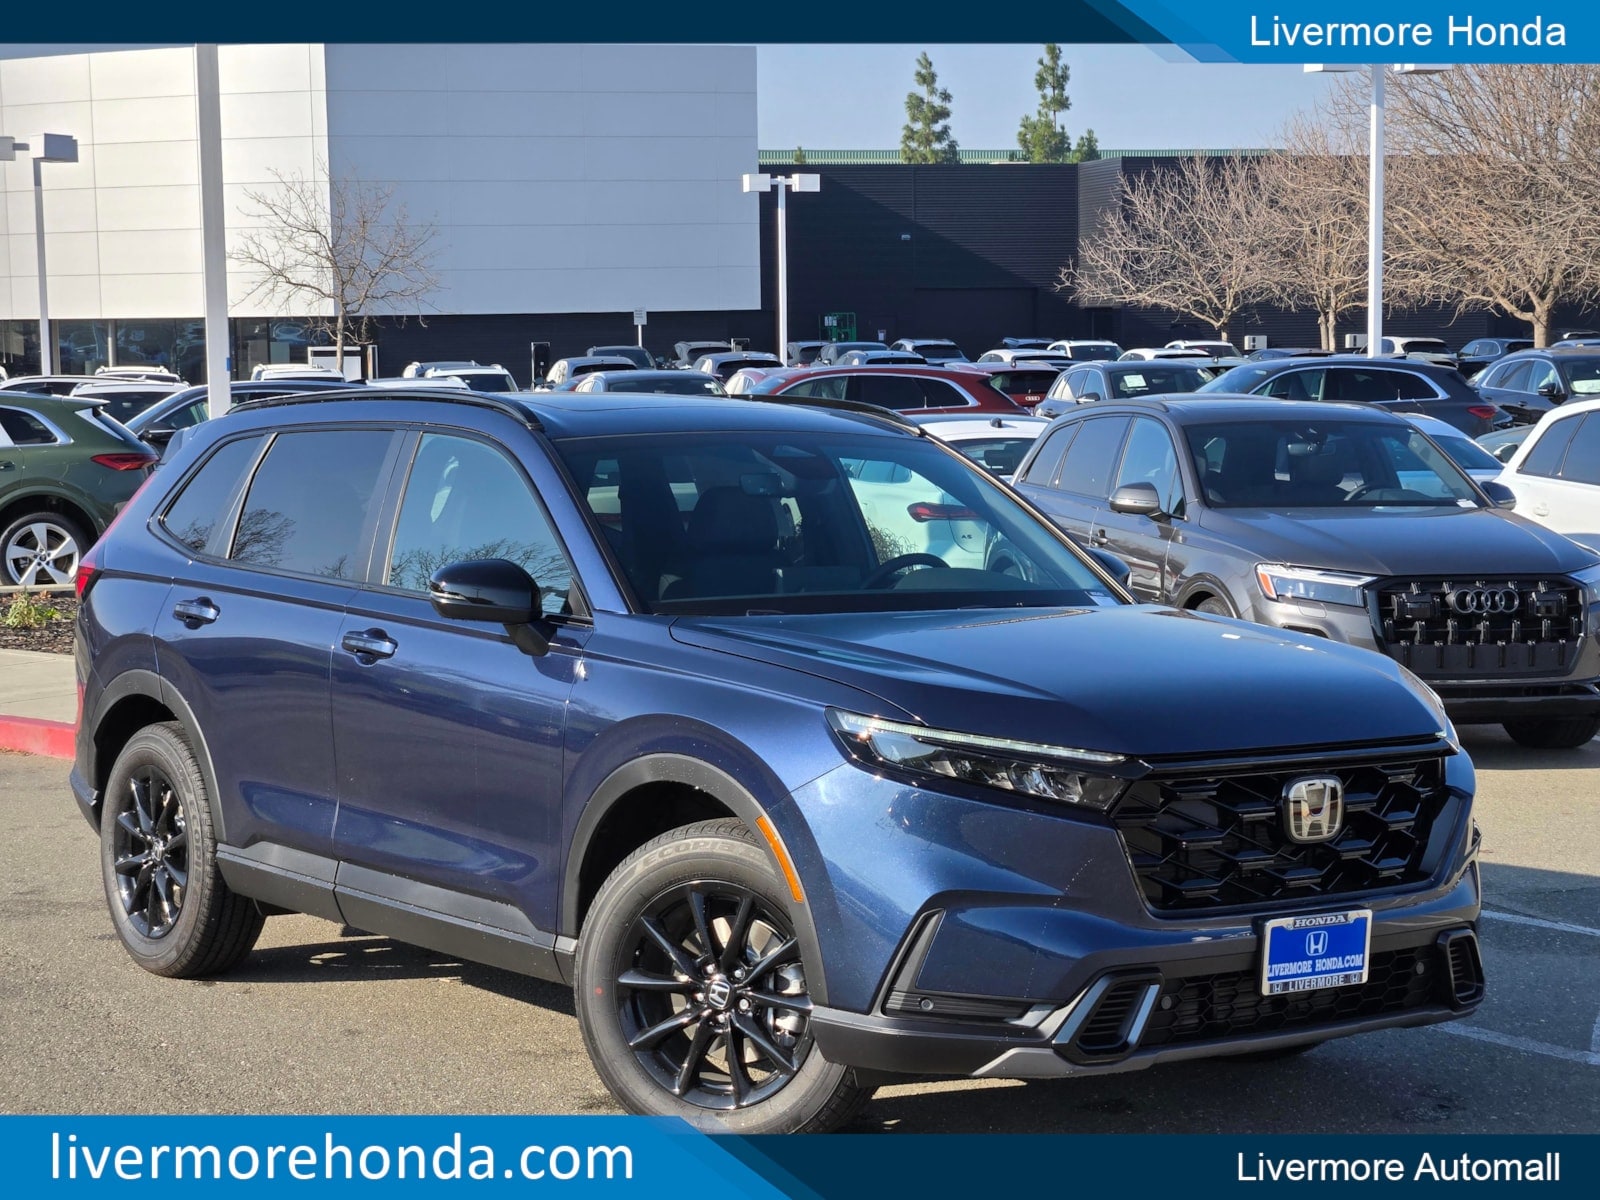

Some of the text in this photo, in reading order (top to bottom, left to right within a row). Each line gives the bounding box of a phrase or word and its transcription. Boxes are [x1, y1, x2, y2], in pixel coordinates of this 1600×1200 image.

[1294, 915, 1346, 928] HONDA
[1268, 954, 1363, 977] LIVERMORE HONDA.COM
[1288, 975, 1345, 991] LIVERMORE
